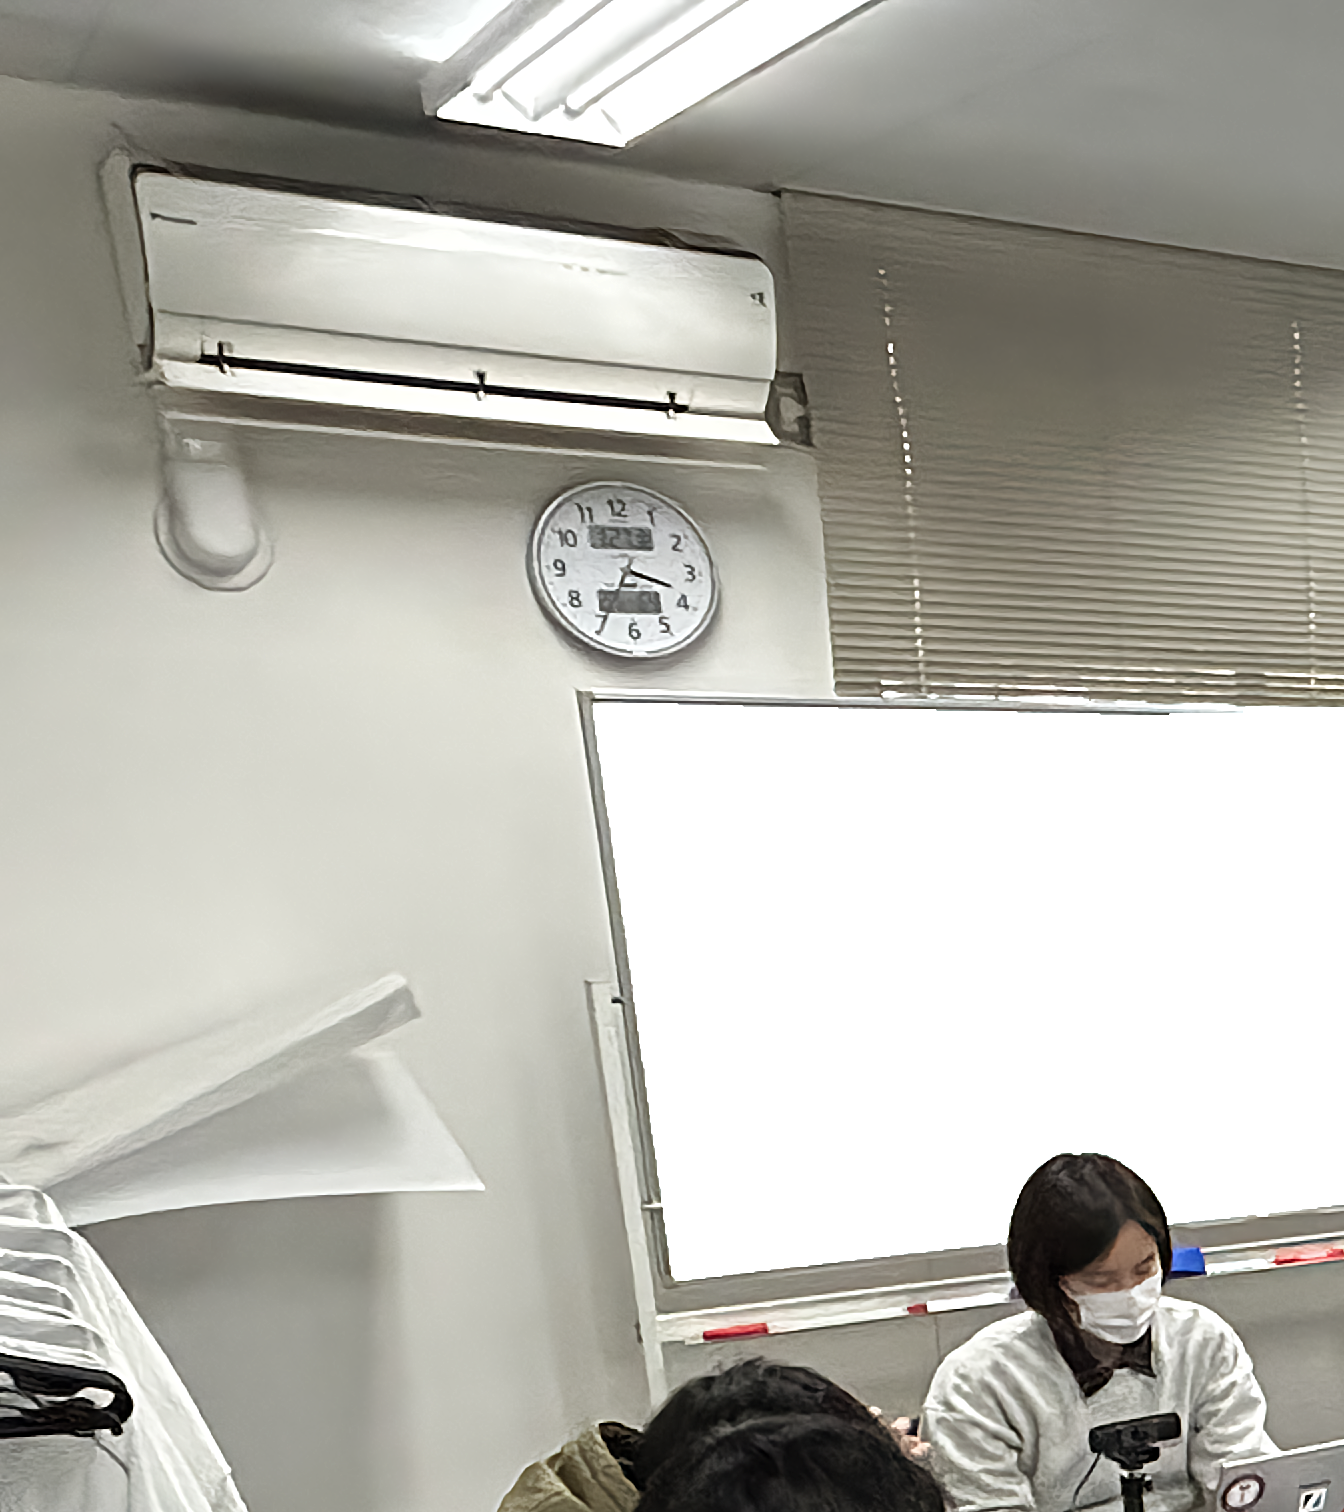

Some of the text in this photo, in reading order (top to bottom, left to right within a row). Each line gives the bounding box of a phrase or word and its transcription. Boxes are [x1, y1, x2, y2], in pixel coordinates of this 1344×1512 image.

[575, 503, 593, 523] 11
[607, 499, 628, 517] 12
[647, 507, 656, 526] 1
[556, 529, 578, 547] 10
[670, 533, 683, 552] 2
[553, 559, 565, 577] 9
[684, 564, 695, 582] 3
[568, 590, 582, 607] 8
[677, 594, 690, 611] 4
[595, 614, 608, 635] 7
[628, 622, 641, 640] 6
[659, 616, 670, 634] 5
